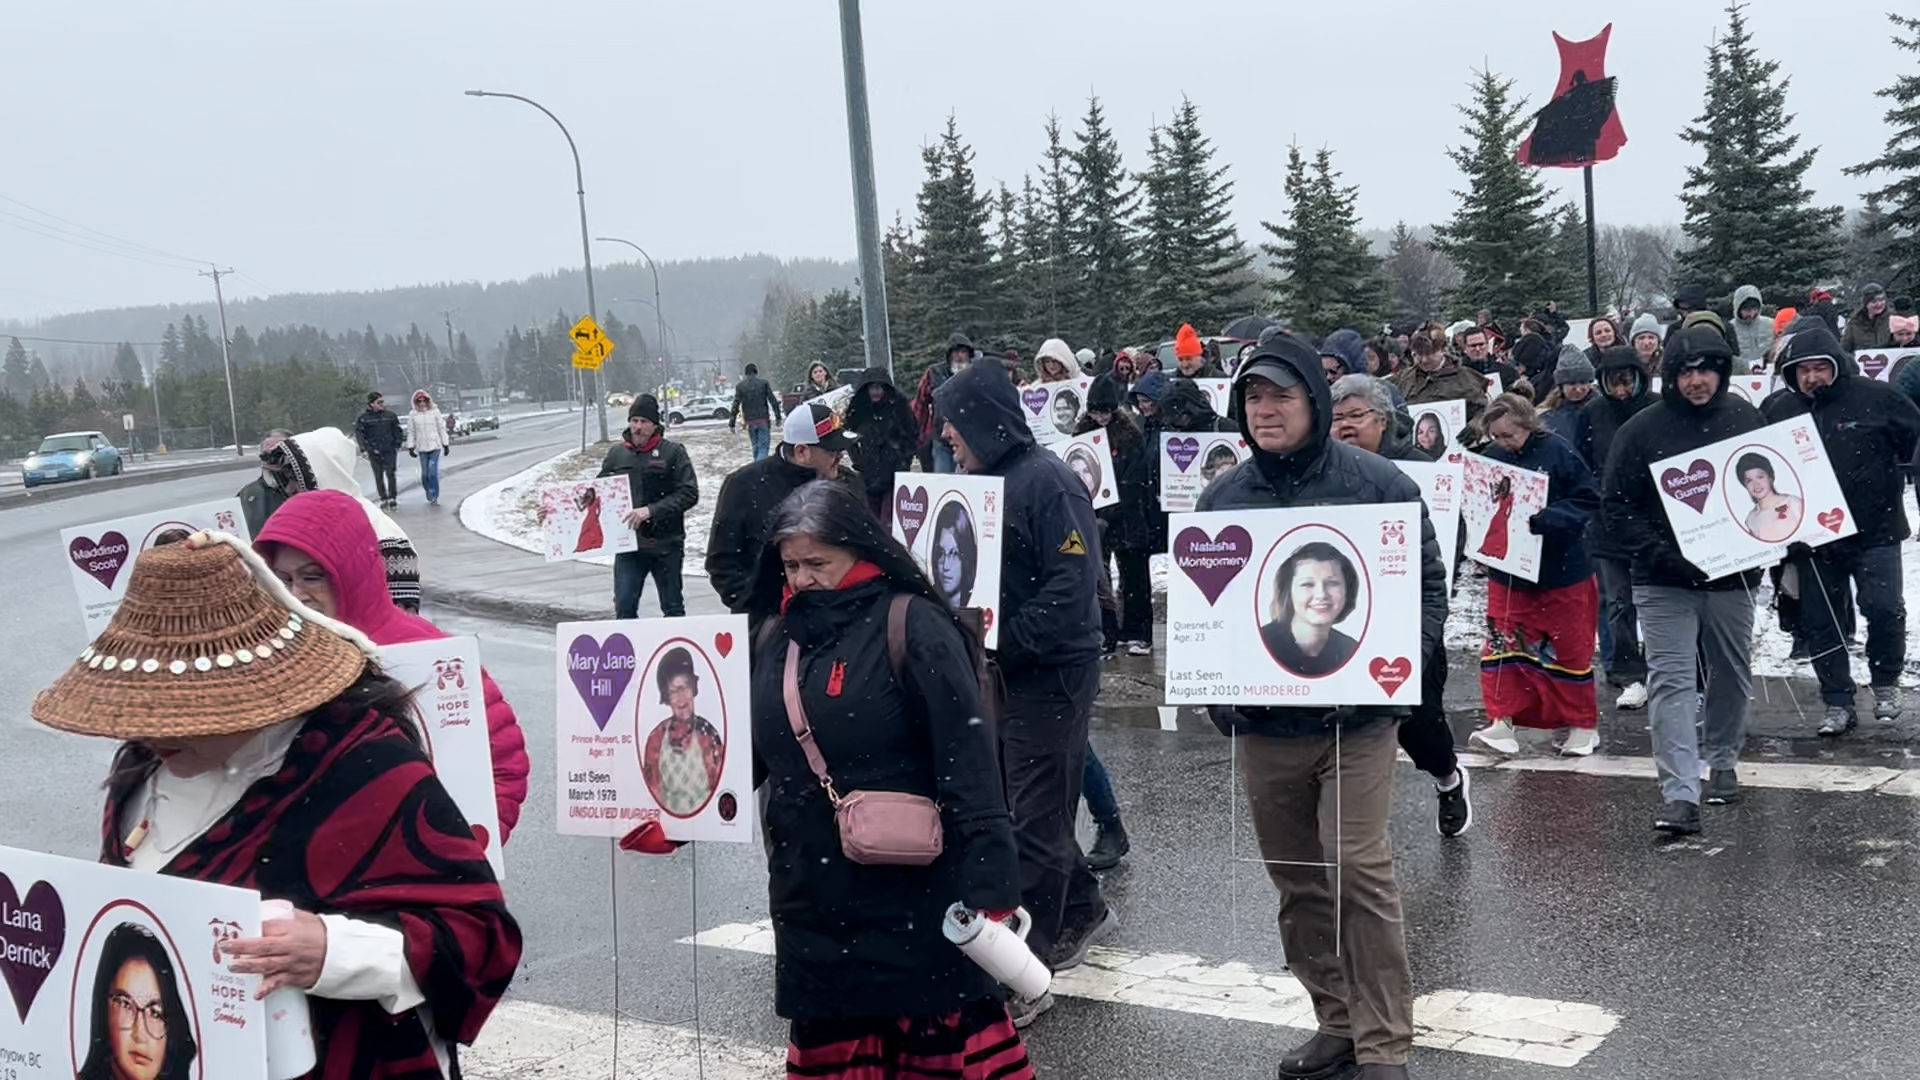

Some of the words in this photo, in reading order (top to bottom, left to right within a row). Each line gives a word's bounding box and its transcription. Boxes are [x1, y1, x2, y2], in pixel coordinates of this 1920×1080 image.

[1667, 469, 1710, 489] Michelle
[900, 499, 924, 513] Monica
[72, 544, 127, 561] Maddison
[1189, 541, 1237, 552] Natasha
[88, 559, 119, 571] Scott
[1179, 556, 1248, 568] Montgomery
[1379, 555, 1407, 563] HOPE
[1173, 621, 1211, 632] Quesnel,
[1212, 620, 1225, 630] BC
[1173, 633, 1193, 644] Age:
[566, 652, 601, 675] Mary
[602, 651, 636, 670] Jane
[1169, 670, 1193, 681] Last
[1195, 669, 1223, 681] Seen
[591, 678, 612, 697] Hill
[1169, 685, 1208, 699] August
[1211, 684, 1240, 696] 2010
[1243, 685, 1311, 696] MURDERED
[437, 700, 469, 711] HOPE
[621, 734, 633, 744] BC
[568, 771, 587, 783] Last
[588, 770, 611, 783] Seen
[568, 788, 595, 801] March
[597, 788, 617, 801] 1978
[568, 805, 618, 819] UNSOLVED
[620, 807, 662, 820] MURDER
[3, 901, 43, 932] Lana
[0, 935, 51, 970] Derrick
[211, 984, 246, 1002] HOPE
[29, 1051, 42, 1069] BC
